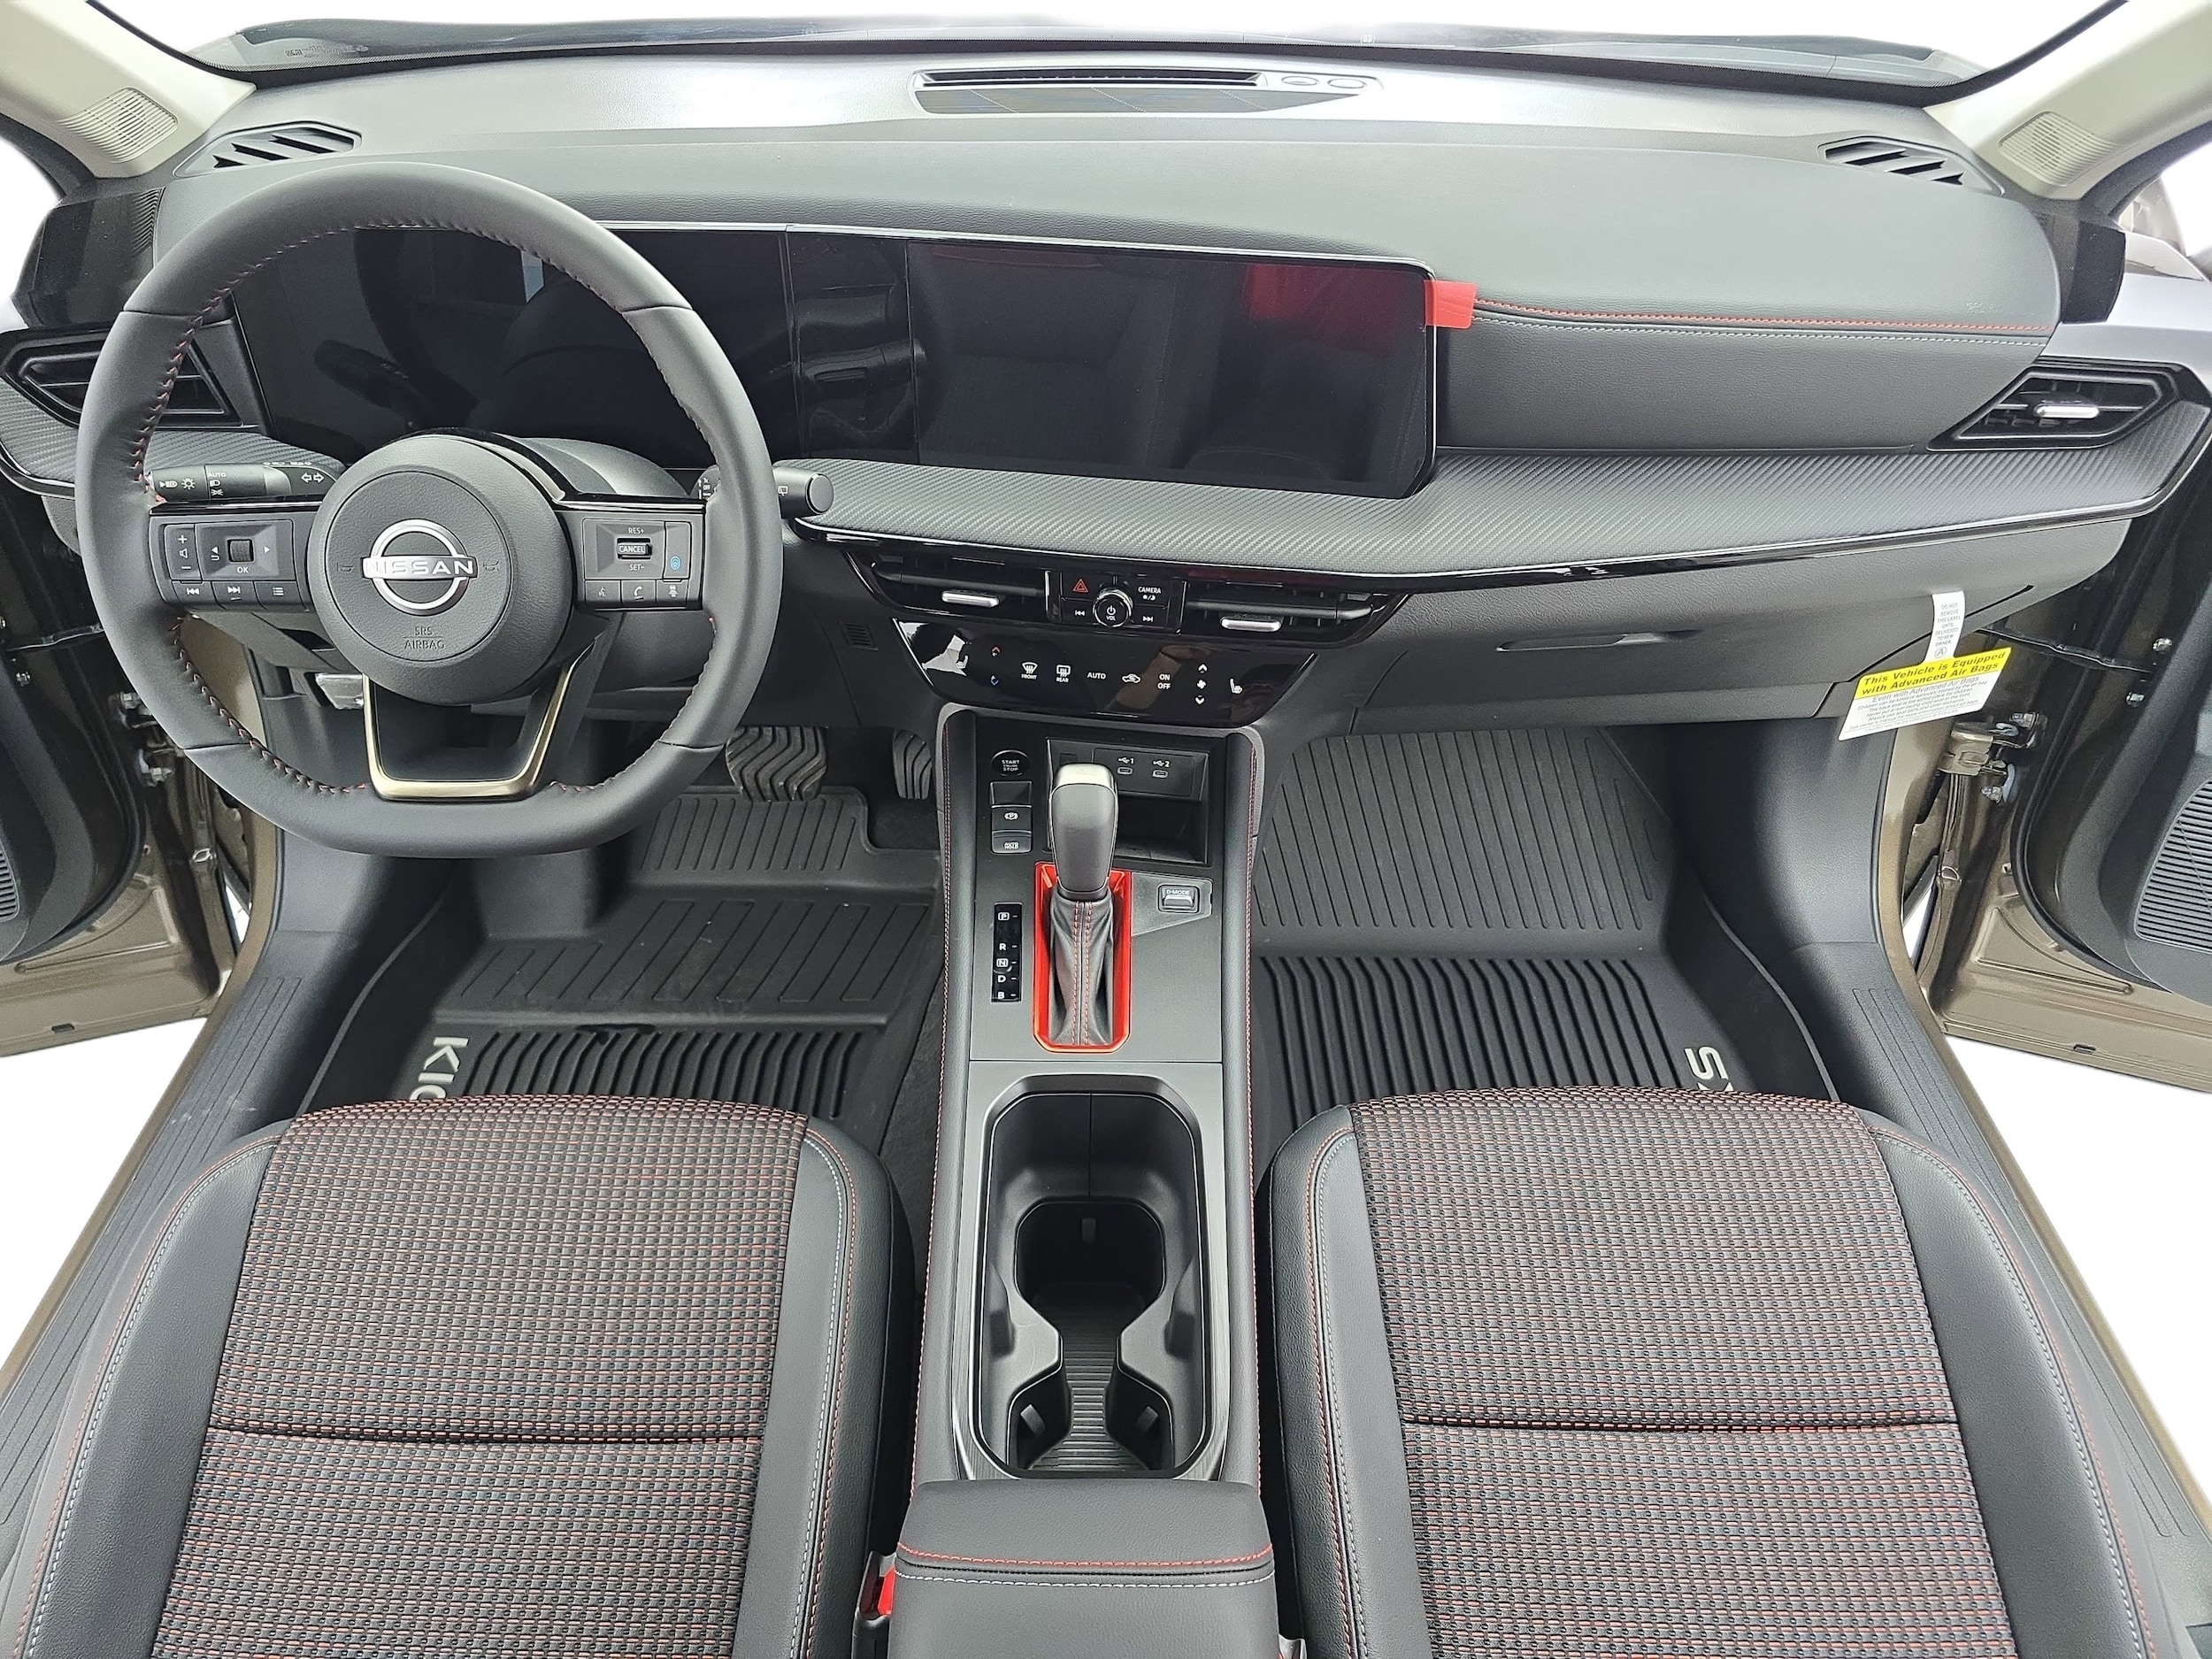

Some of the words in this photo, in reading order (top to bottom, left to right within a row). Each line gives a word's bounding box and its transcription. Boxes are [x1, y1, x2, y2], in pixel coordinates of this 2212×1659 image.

[366, 561, 474, 575] NISSAN
[1138, 586, 1161, 594] CAMERA
[415, 626, 433, 636] SRS
[404, 640, 445, 650] AIRBAG
[1864, 675, 1888, 685] This
[1893, 667, 1934, 680] Vehicle
[1952, 652, 2006, 667] Equipped
[1862, 686, 1887, 695] with
[1891, 672, 1947, 689] Advanced
[1950, 669, 1968, 677] Air
[1970, 663, 1998, 673] Bags
